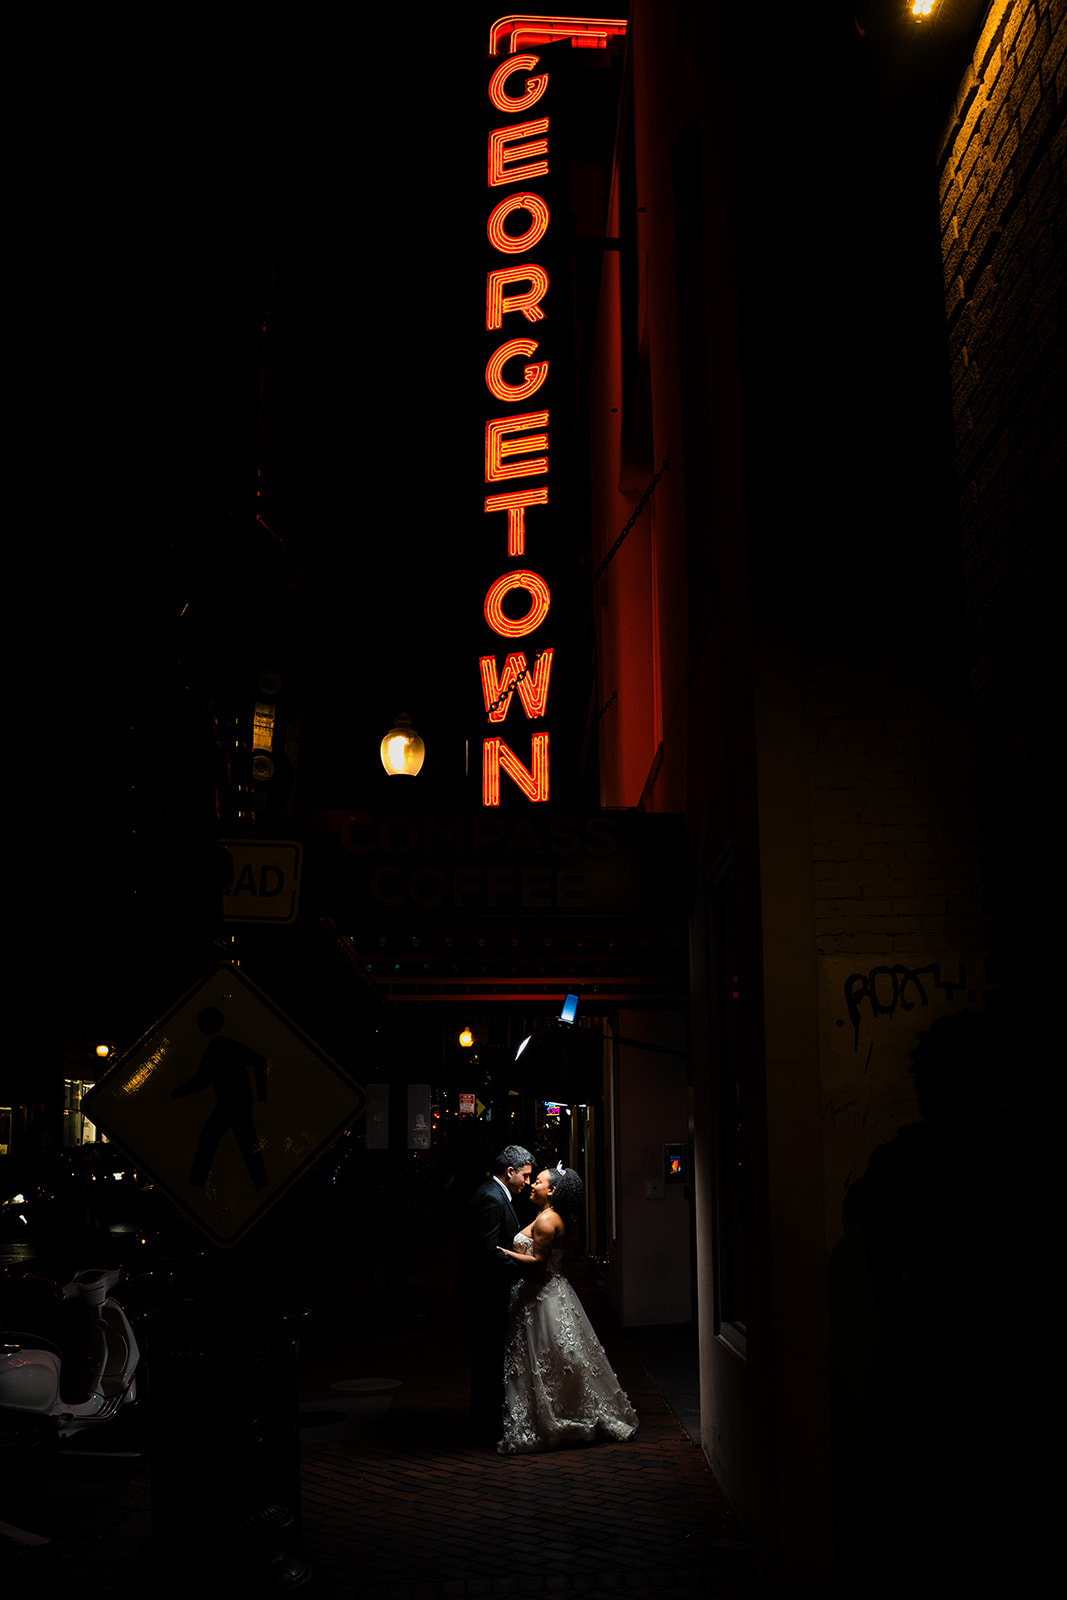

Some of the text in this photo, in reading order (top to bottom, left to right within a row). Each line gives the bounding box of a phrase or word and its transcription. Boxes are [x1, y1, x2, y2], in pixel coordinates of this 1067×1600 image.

[478, 54, 554, 808] GEORGETOWN
[339, 814, 618, 858] COMPASS
[369, 866, 587, 908] COFFEE
